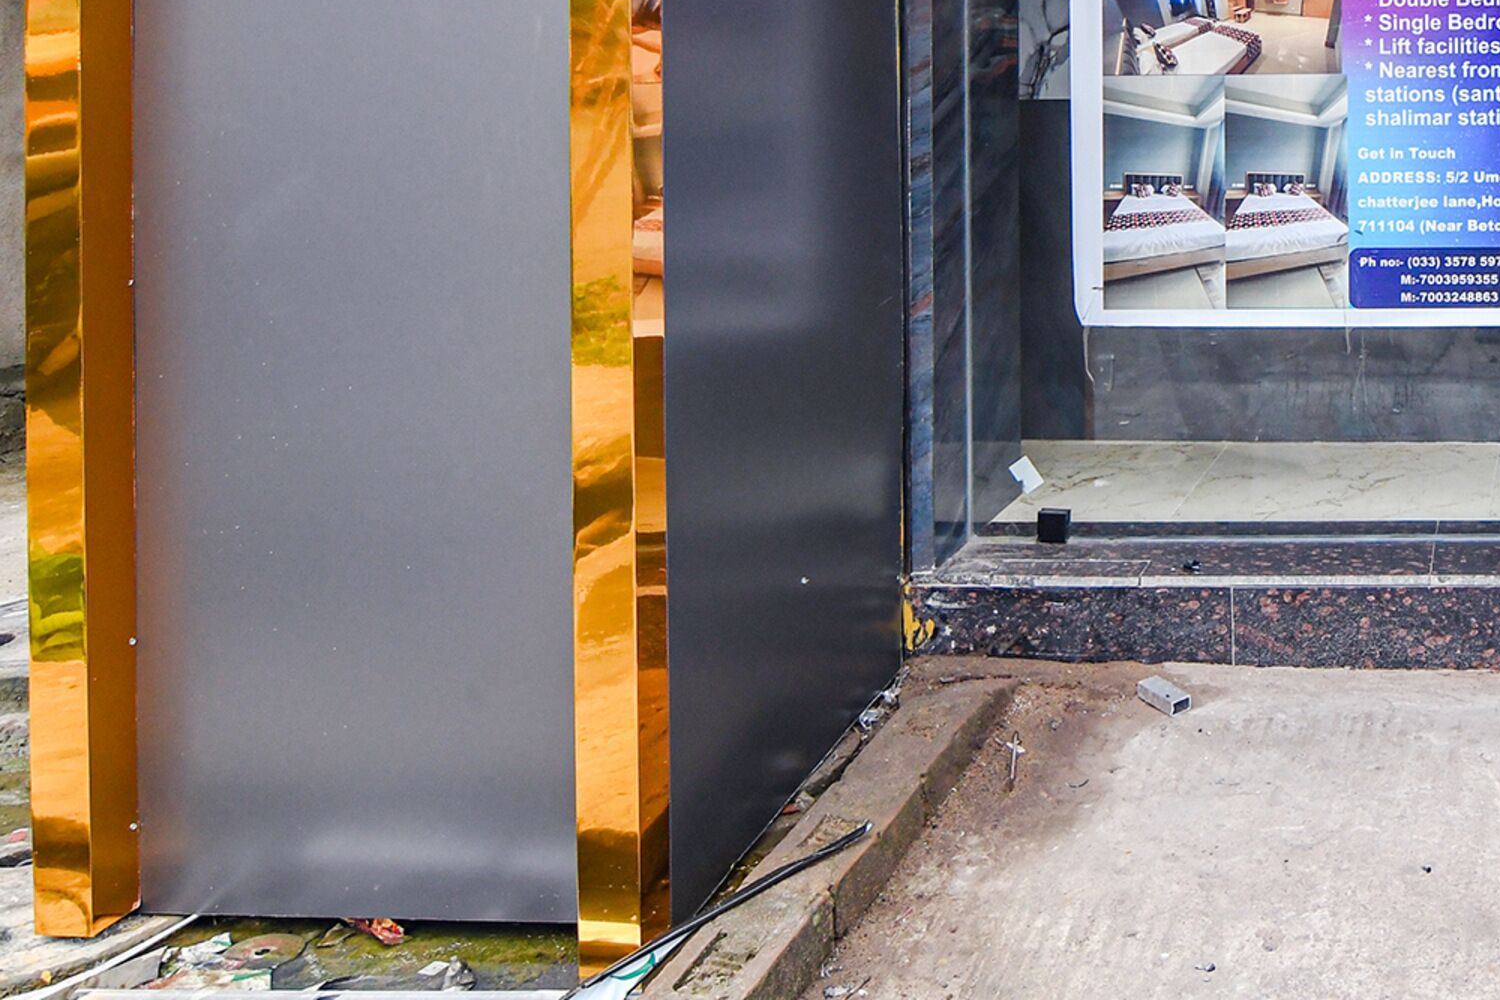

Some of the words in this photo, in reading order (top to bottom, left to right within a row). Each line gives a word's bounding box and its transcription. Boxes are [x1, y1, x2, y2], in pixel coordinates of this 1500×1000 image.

[1378, 13, 1442, 35] Single
[1379, 37, 1412, 55] Lift
[1379, 61, 1457, 79] Nearest
[1365, 85, 1446, 103] stations
[1365, 109, 1452, 127] shalimar
[1358, 147, 1386, 160] Get
[1409, 147, 1456, 160] Touch
[1358, 171, 1441, 184] ADDRESS:
[1446, 171, 1469, 184] 5/2
[1358, 196, 1438, 210] chatterjee
[1358, 220, 1415, 233] 711104
[1420, 219, 1463, 235] (Near
[1359, 257, 1376, 268] Ph
[1407, 256, 1441, 270] (033)
[1444, 257, 1476, 267] 3578
